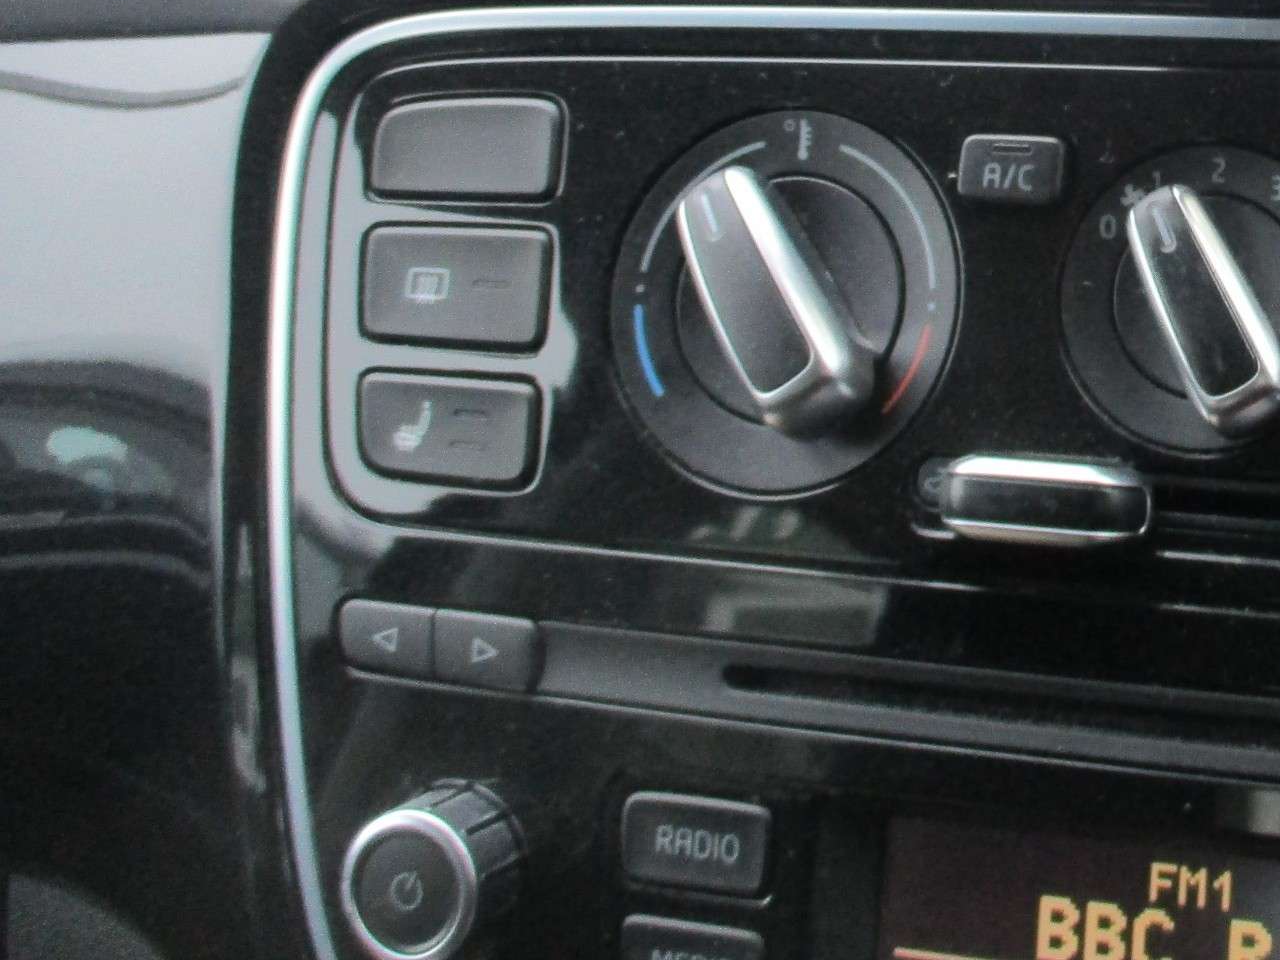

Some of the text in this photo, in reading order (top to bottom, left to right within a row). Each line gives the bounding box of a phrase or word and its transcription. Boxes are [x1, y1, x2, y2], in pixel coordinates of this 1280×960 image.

[982, 163, 1034, 191] A/C
[1211, 158, 1227, 184] 2
[655, 824, 740, 864] RADIO
[1150, 861, 1233, 912] FM1
[1036, 895, 1175, 960] BBC
